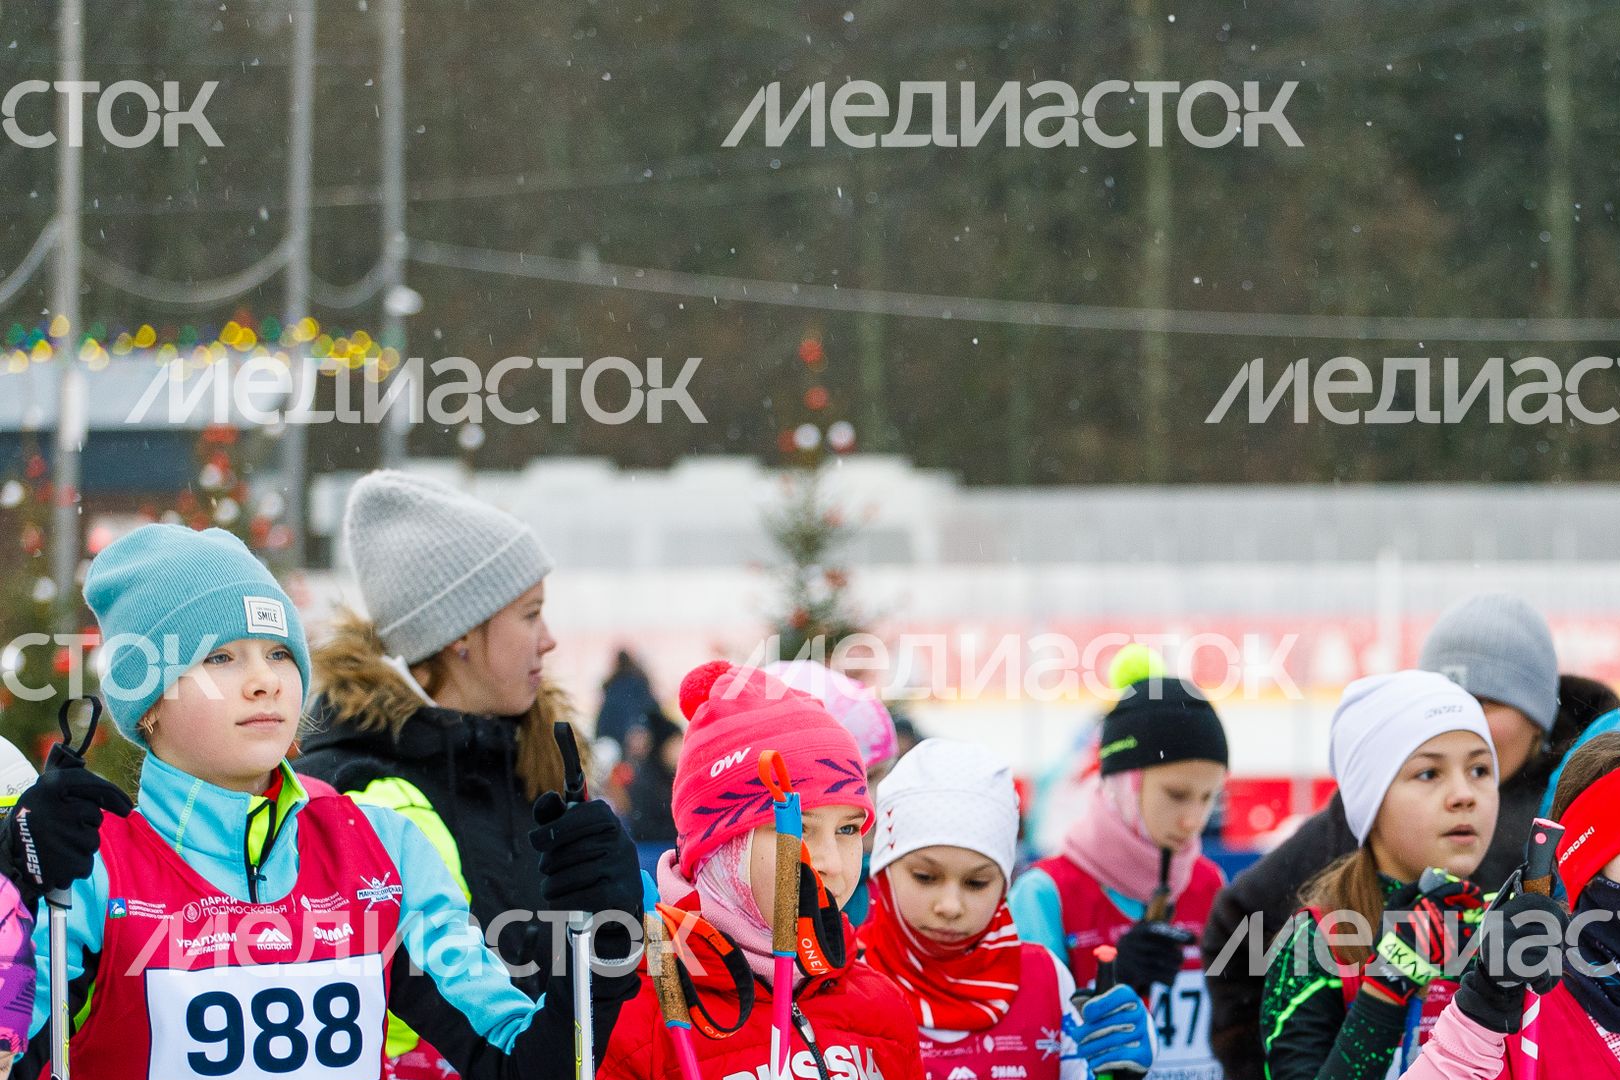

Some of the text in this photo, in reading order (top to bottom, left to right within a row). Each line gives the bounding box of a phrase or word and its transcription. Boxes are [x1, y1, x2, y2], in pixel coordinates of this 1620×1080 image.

[256, 611, 279, 623] SMILE
[201, 896, 238, 906] ПАРКИ
[203, 904, 287, 916] ПОДМОСКОВЬЯ
[186, 982, 363, 1076] 988
